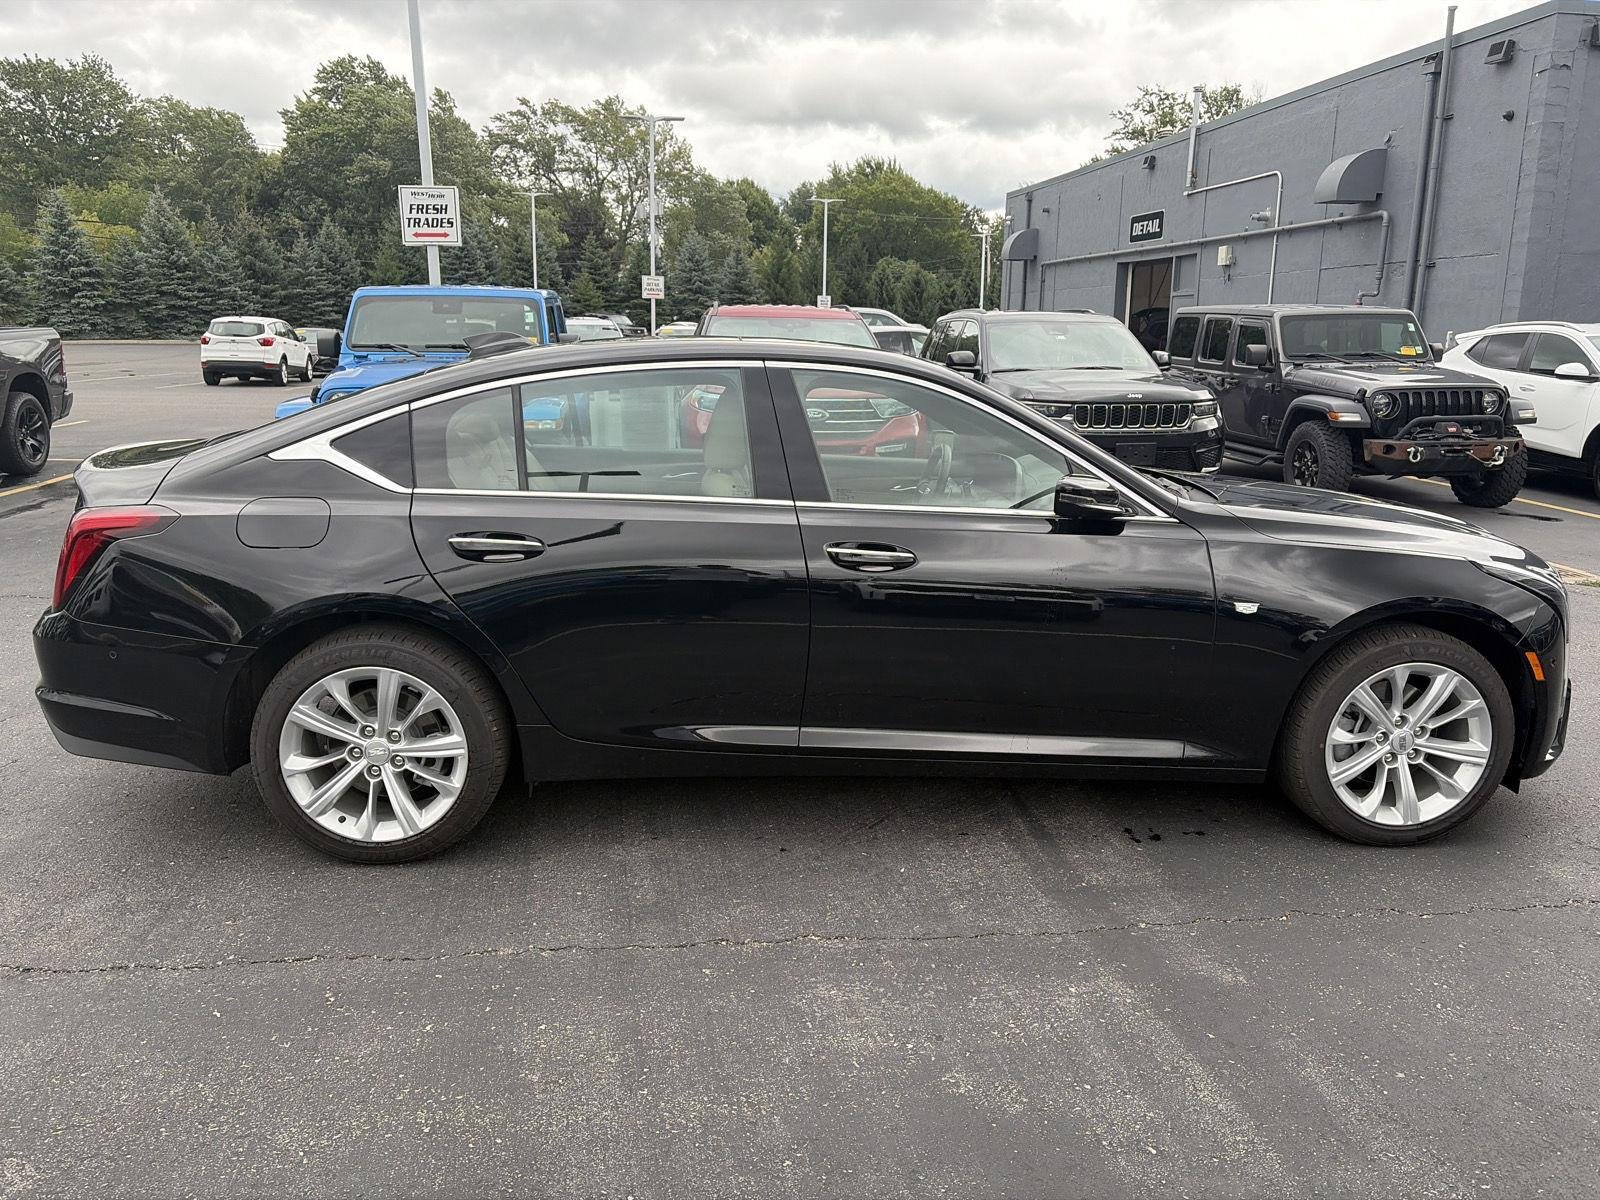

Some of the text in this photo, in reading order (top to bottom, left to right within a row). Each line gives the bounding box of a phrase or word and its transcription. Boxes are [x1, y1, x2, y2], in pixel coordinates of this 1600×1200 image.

[409, 203, 448, 215] FRESH
[405, 217, 454, 228] TRADES
[1132, 219, 1160, 235] DETAIL
